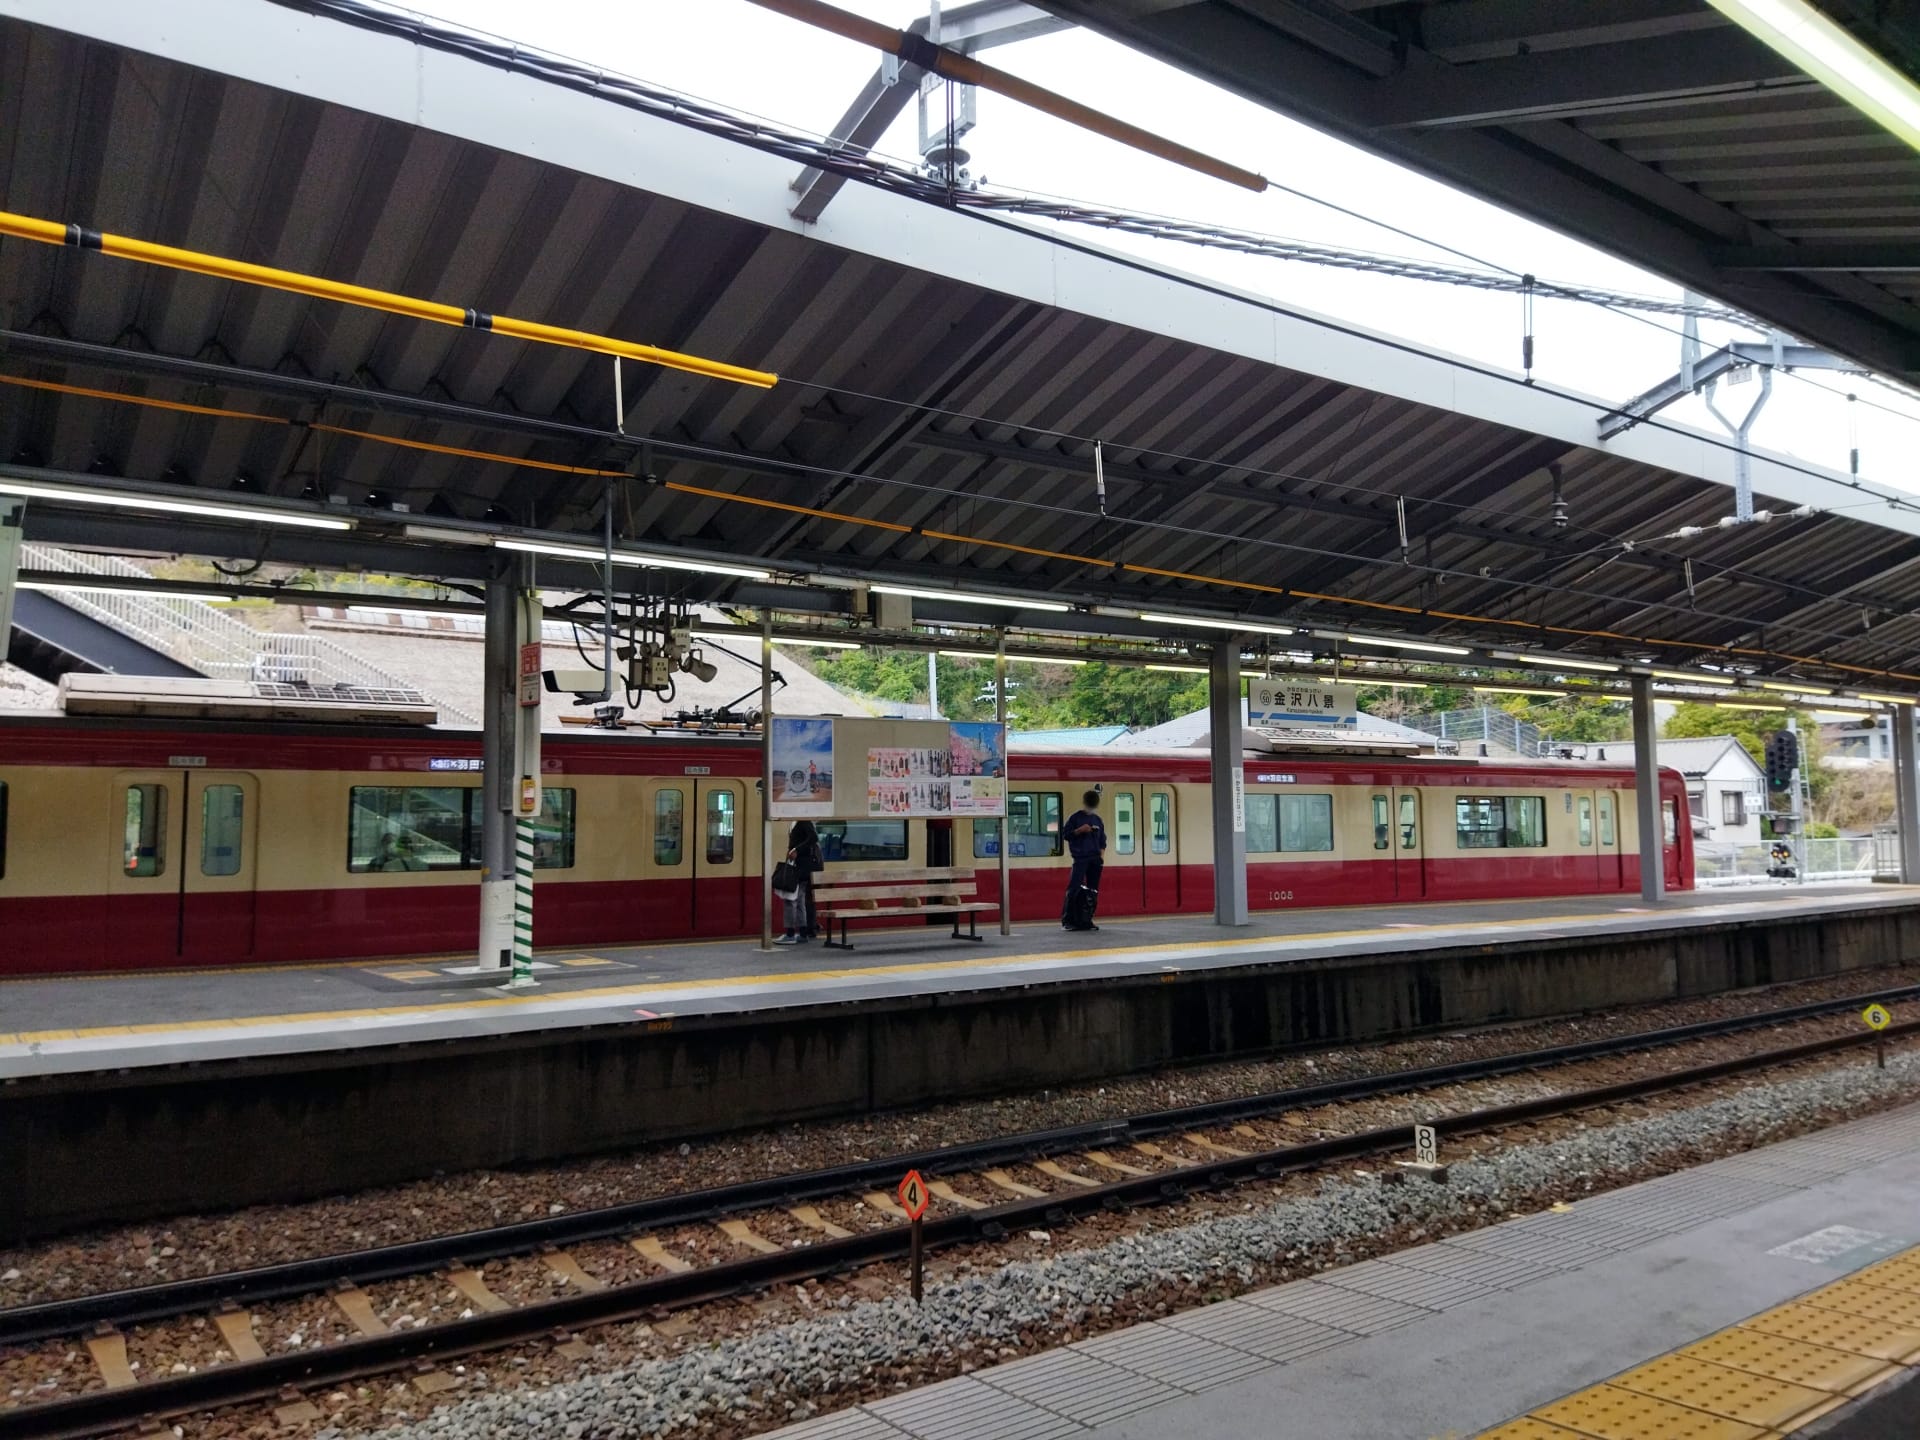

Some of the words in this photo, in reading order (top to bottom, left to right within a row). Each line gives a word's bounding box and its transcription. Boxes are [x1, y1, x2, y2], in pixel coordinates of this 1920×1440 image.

[1274, 691, 1334, 709] 金沢八景
[1872, 1011, 1881, 1023] 6
[1419, 1128, 1432, 1149] 8
[1417, 1149, 1434, 1164] 40
[908, 1182, 918, 1207] 4
